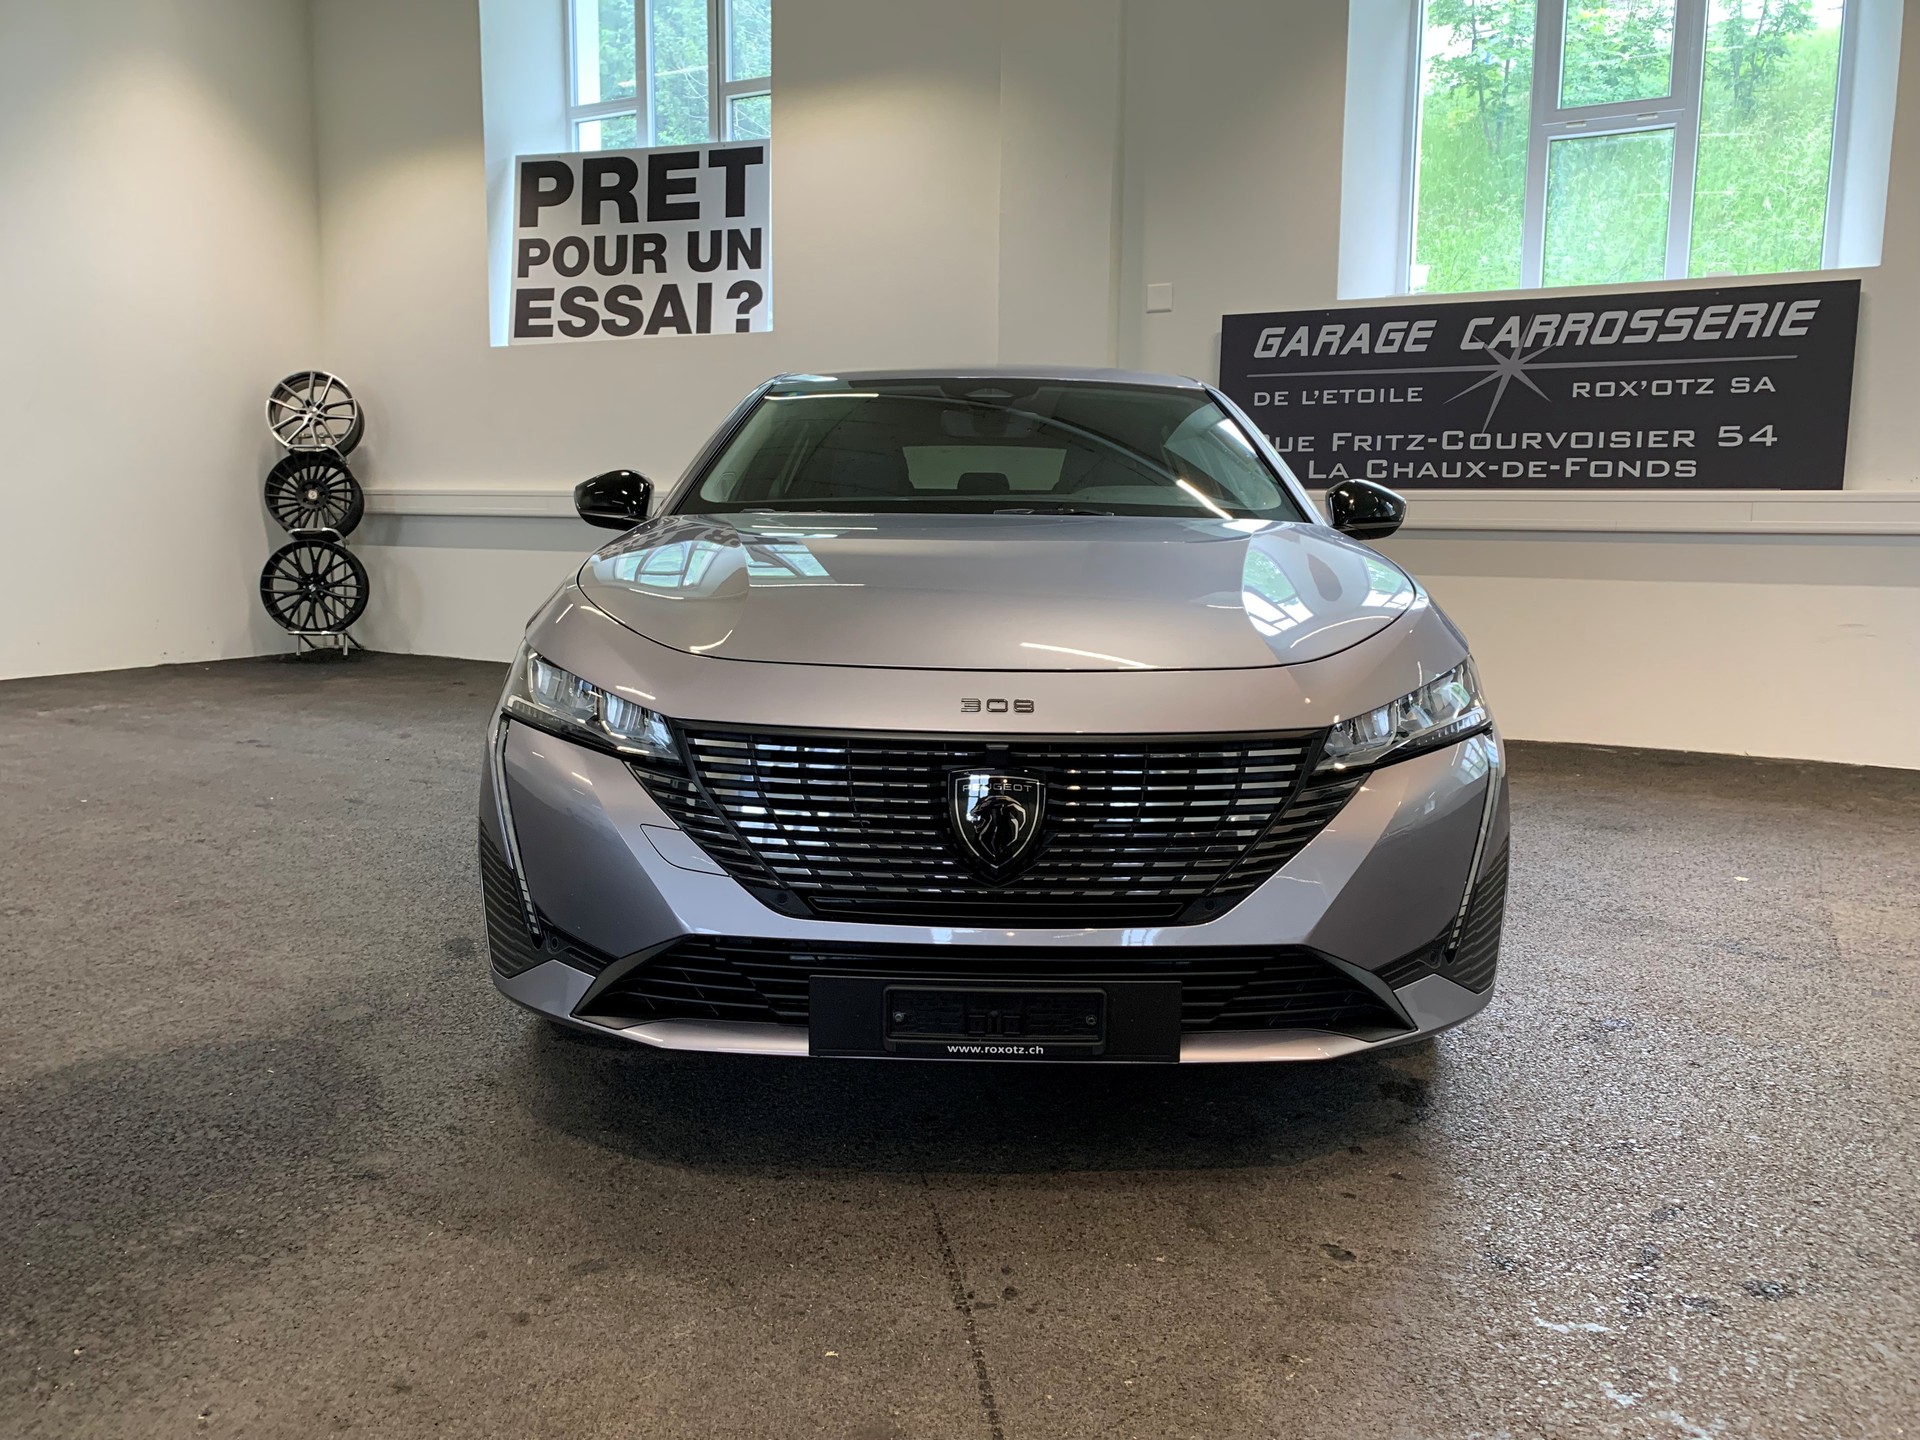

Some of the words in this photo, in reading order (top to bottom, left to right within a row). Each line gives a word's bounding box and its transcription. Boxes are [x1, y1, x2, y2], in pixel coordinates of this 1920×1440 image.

[519, 146, 763, 227] PRET
[517, 233, 667, 278] POUR
[687, 227, 762, 272] UN
[1253, 319, 1437, 359] GARAGE
[1460, 300, 1821, 349] CARROSSERIE
[1730, 376, 1776, 393] SA
[1254, 391, 1289, 406] DE
[1717, 424, 1778, 447] 54
[1308, 459, 1350, 479] LA
[961, 698, 1034, 713] 308
[947, 1045, 1044, 1055] www.roxotz.ch
